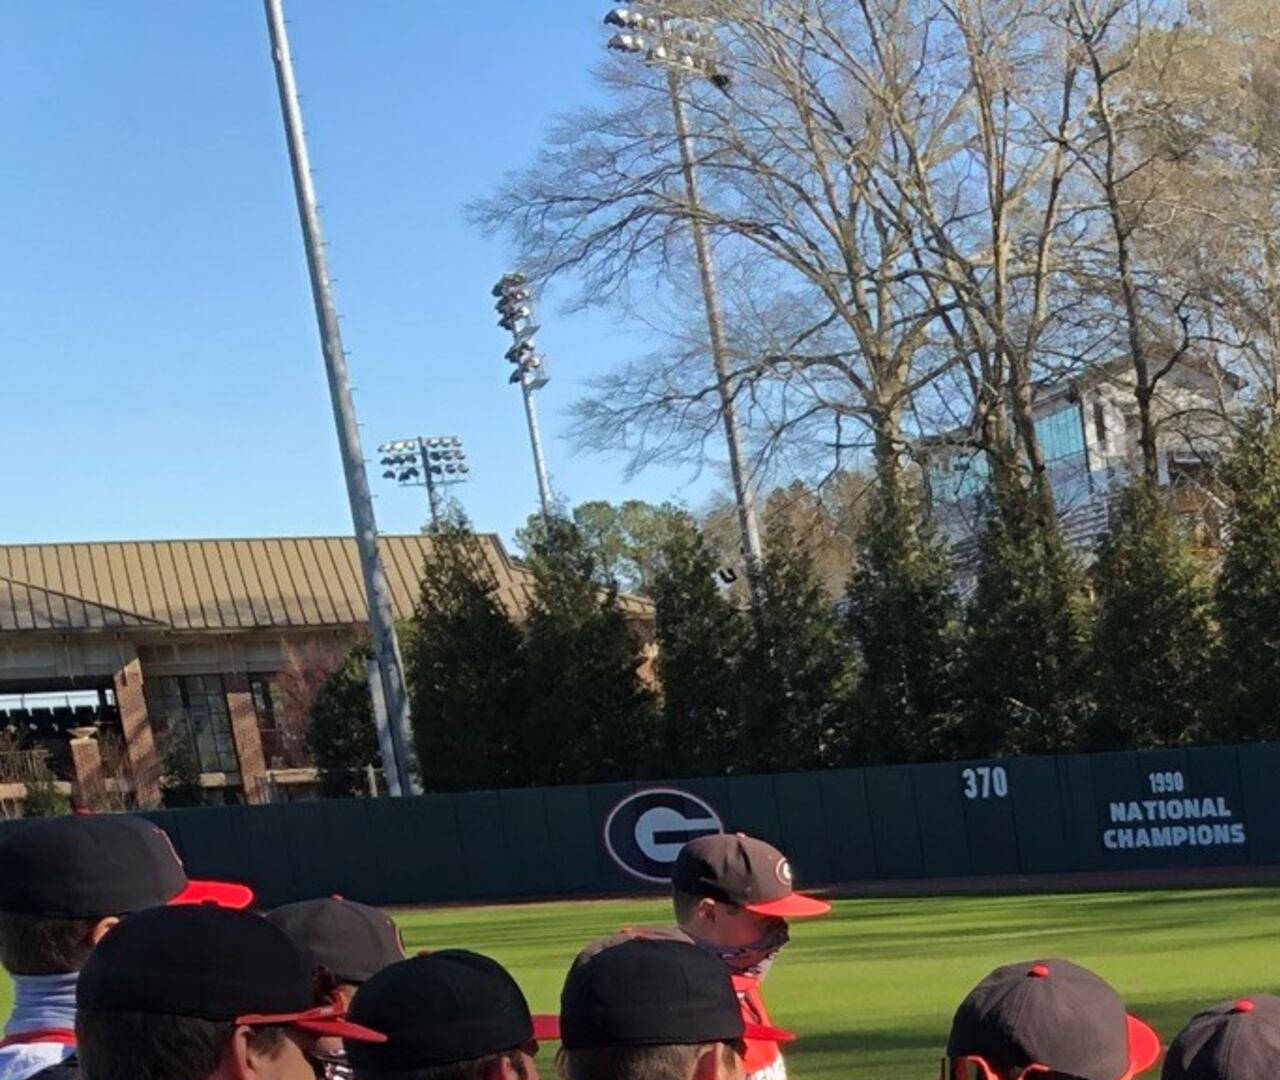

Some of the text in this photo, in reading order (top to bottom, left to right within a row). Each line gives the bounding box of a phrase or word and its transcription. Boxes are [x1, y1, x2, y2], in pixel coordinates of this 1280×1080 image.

[962, 766, 1008, 799] 370
[1149, 771, 1184, 793] 1990
[1110, 797, 1231, 822] NATIONAL
[1103, 823, 1246, 849] CHAMPIONS
